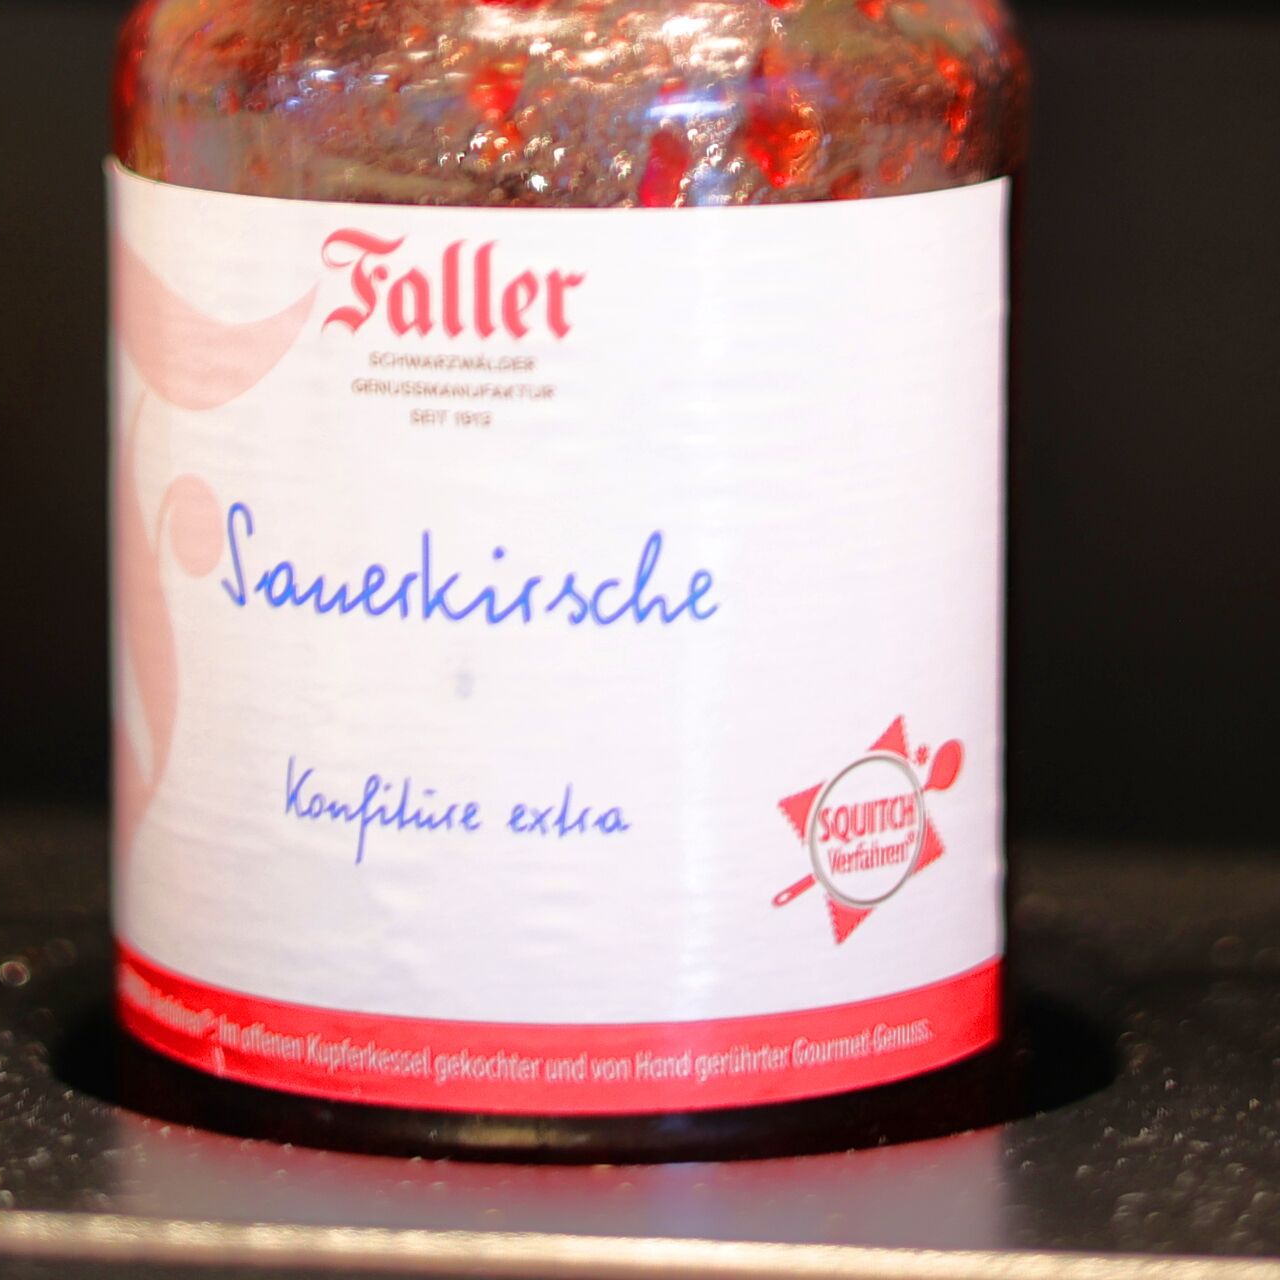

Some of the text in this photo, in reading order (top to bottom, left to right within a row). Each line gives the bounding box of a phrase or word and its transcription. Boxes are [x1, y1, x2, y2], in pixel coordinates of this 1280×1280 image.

[320, 227, 586, 340] Faller
[409, 407, 449, 426] SEIT
[222, 500, 721, 626] Sauerkirsche
[506, 781, 631, 839] extra
[819, 792, 917, 844] SQUITCH
[241, 1021, 305, 1064] offenen
[307, 1031, 433, 1077] Kupferkessel
[434, 1047, 541, 1087] gekochter
[545, 1049, 587, 1082] und
[591, 1057, 631, 1083] von
[634, 1048, 692, 1080] Hand
[695, 1041, 792, 1084] gerührter
